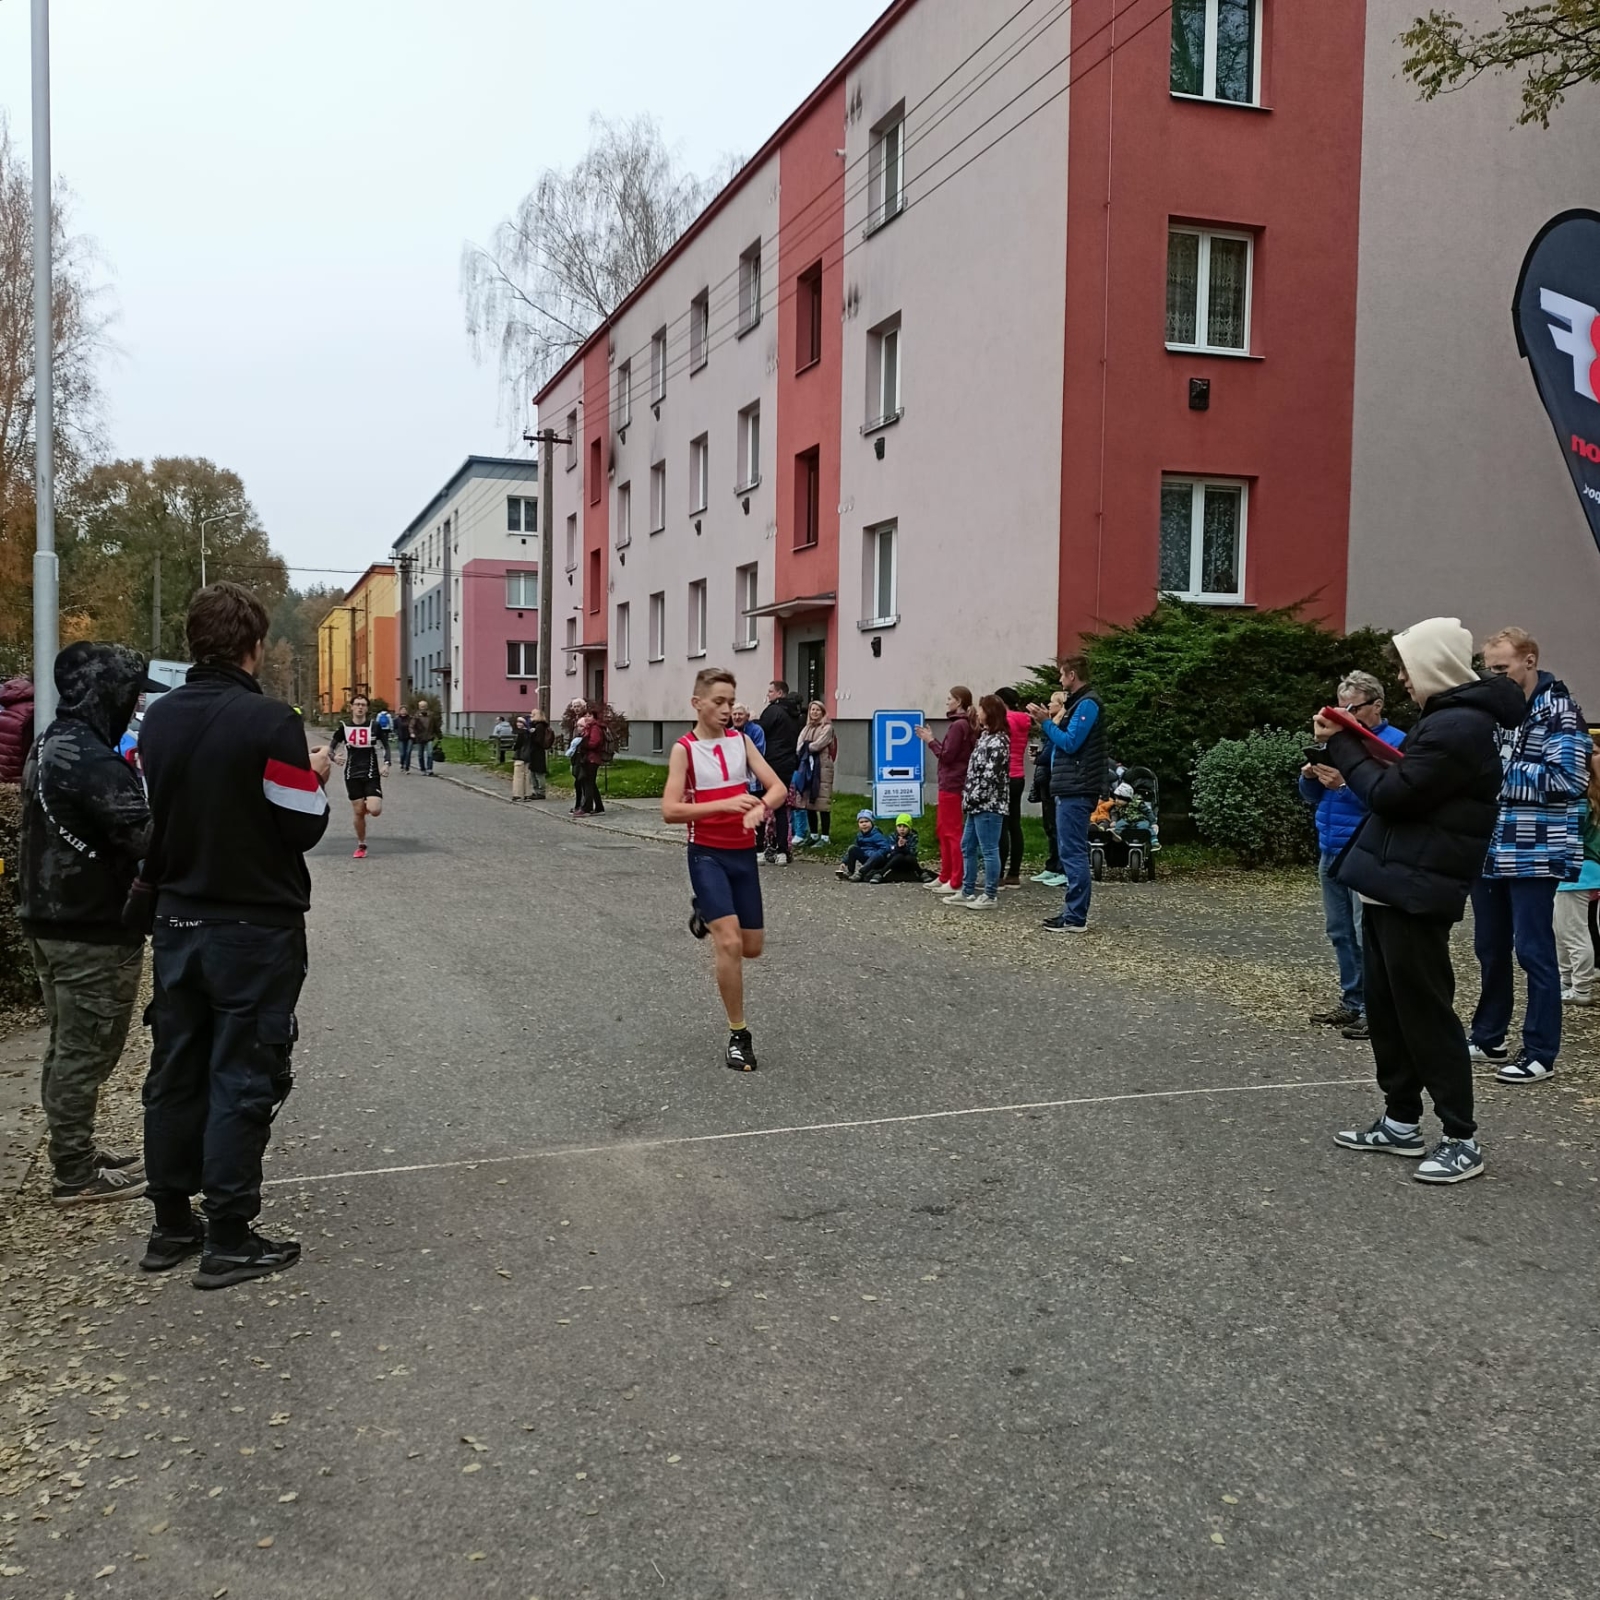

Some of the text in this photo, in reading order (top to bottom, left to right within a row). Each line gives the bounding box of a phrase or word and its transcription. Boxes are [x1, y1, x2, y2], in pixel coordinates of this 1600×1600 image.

[348, 728, 368, 745] 49
[885, 720, 912, 761] P
[712, 743, 730, 782] 1
[59, 825, 87, 852] HIYA
